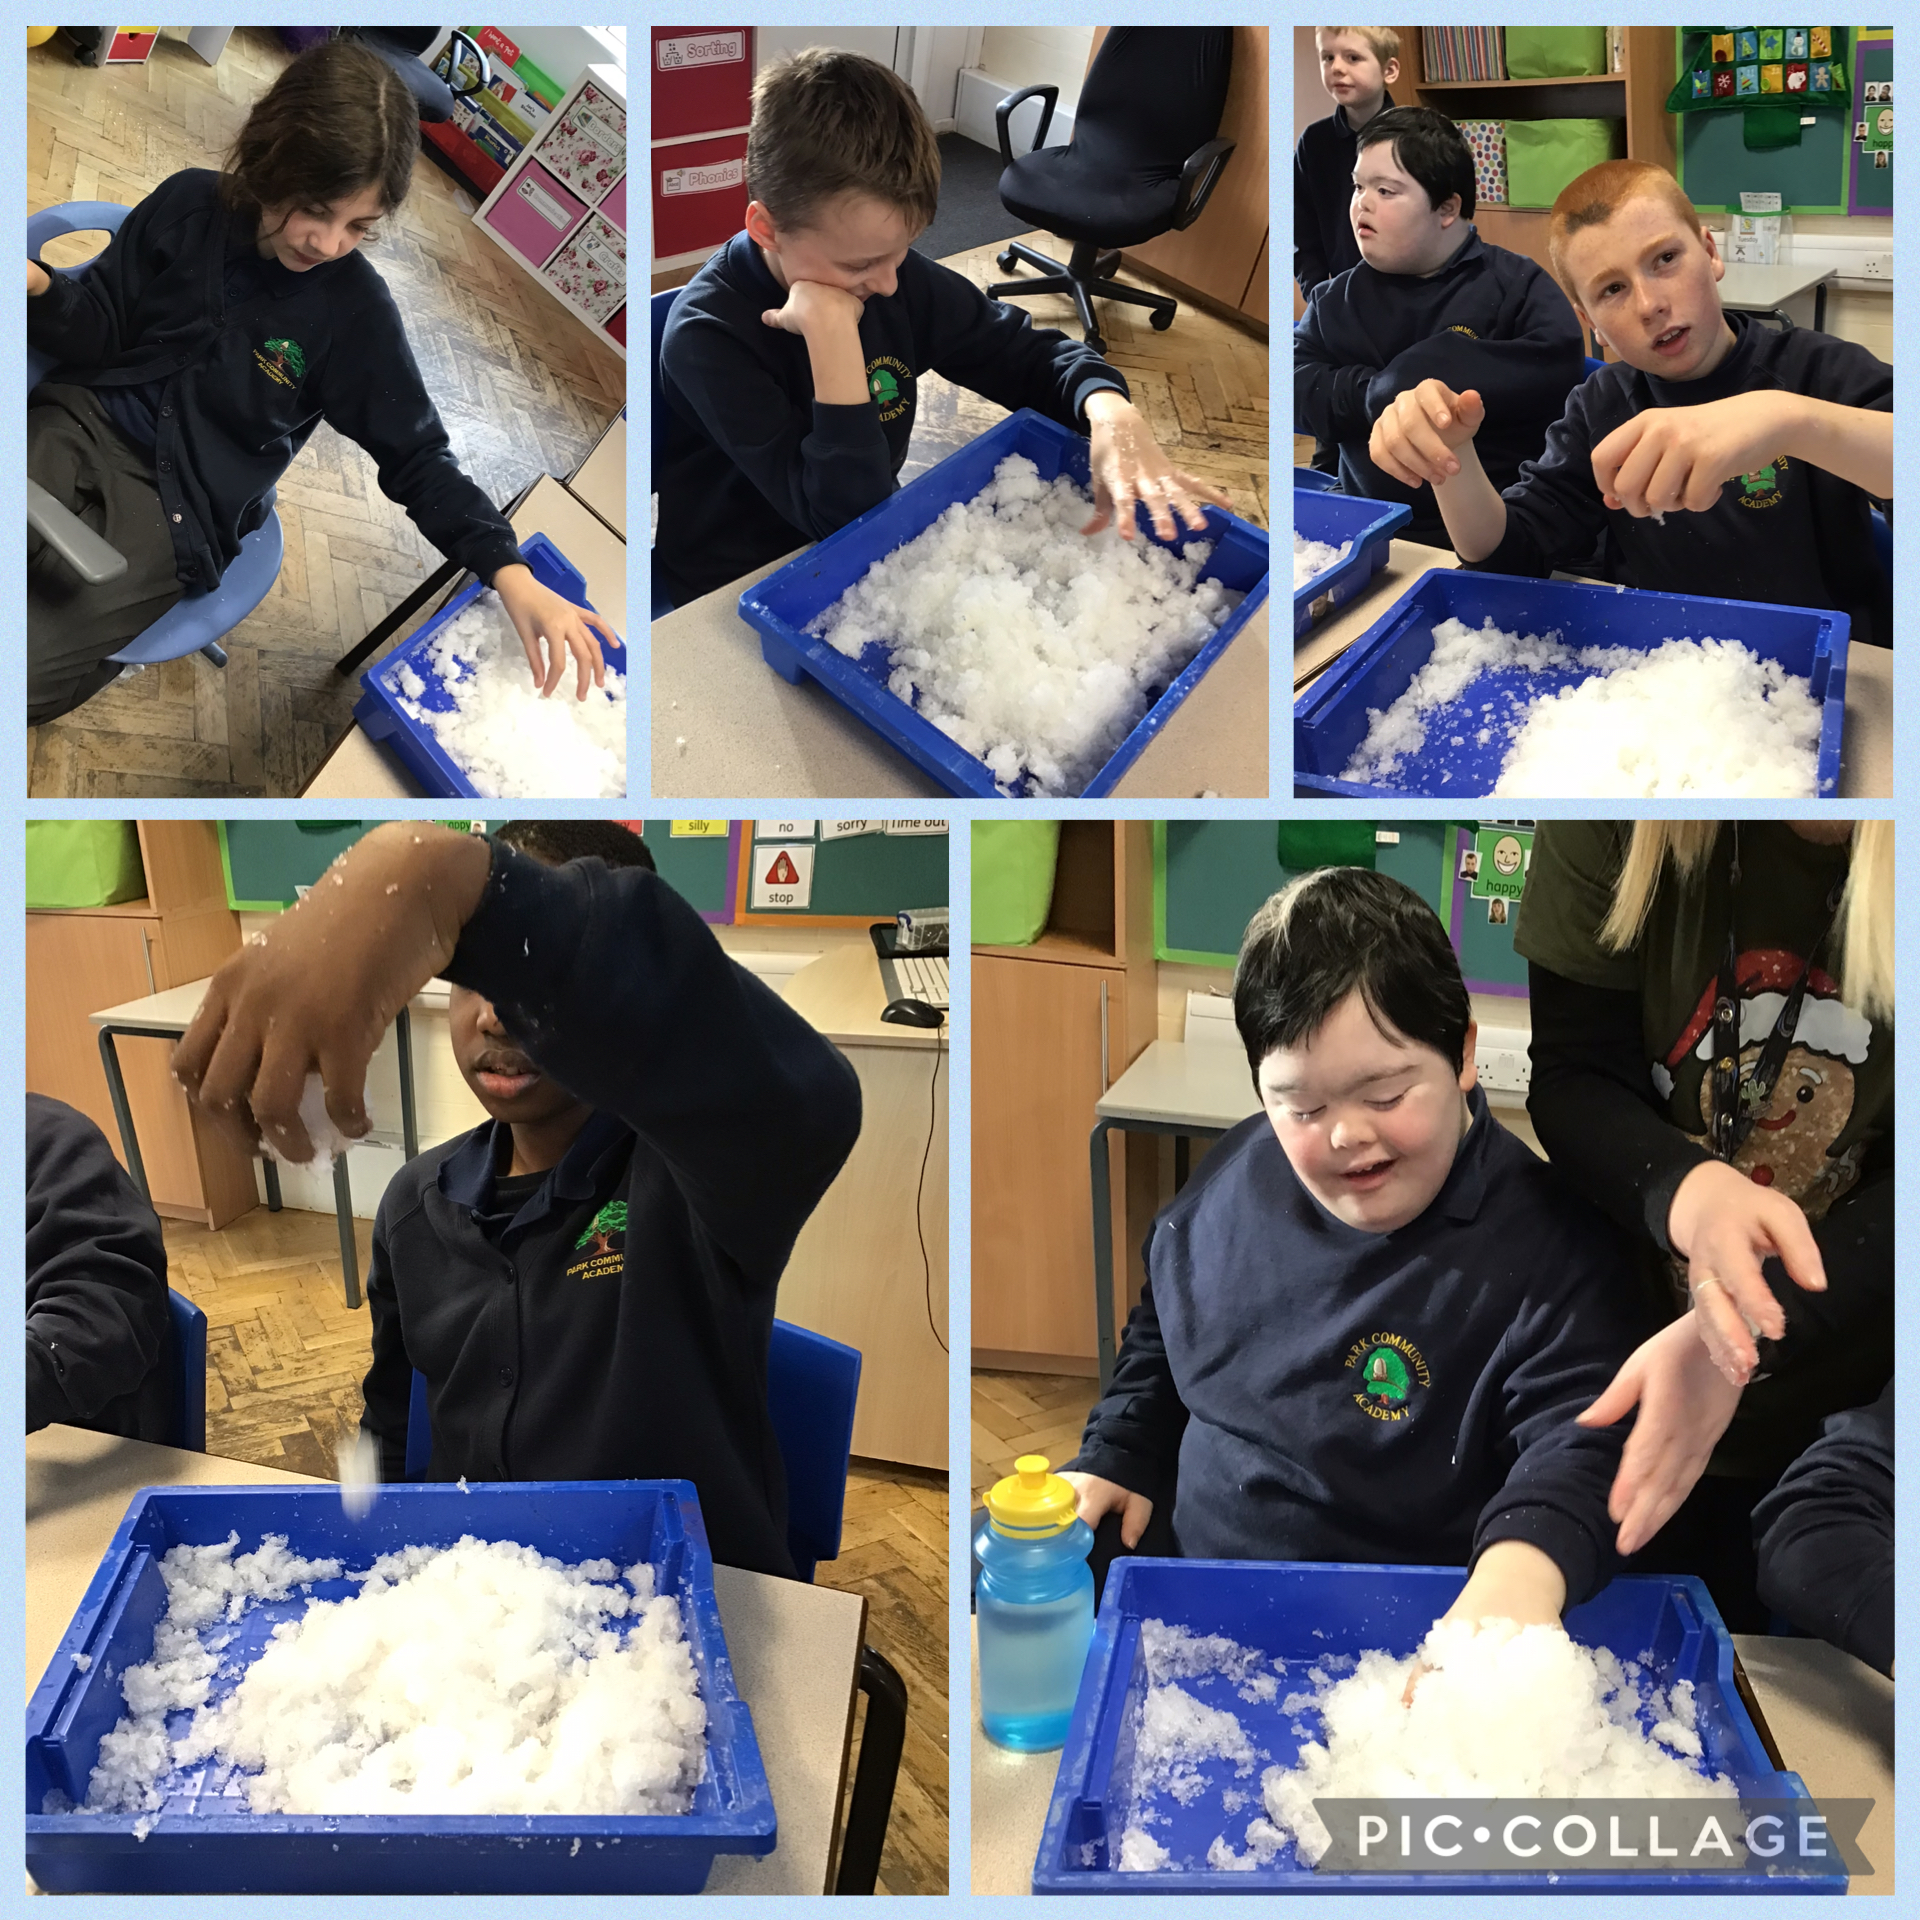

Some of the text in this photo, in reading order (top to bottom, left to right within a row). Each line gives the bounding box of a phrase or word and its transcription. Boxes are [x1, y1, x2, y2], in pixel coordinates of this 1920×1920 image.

[687, 40, 737, 58] Sorting
[1872, 139, 1893, 149] happ
[689, 168, 739, 186] Phonics
[598, 251, 625, 279] Crafts
[266, 361, 297, 389] COMMUNITY
[866, 356, 913, 378] COMMUNITY
[879, 397, 910, 422] ADEMY
[1738, 490, 1783, 509] ACADEMY
[448, 821, 470, 832] appy
[688, 820, 710, 833] silly
[779, 823, 794, 833] no
[837, 820, 868, 832] sorry
[1486, 879, 1523, 897] happy
[768, 892, 794, 905] stop
[566, 1261, 589, 1277] PARK
[1344, 1332, 1431, 1388] PARK COMMUNITY
[1353, 1393, 1409, 1421] ACADEMY
